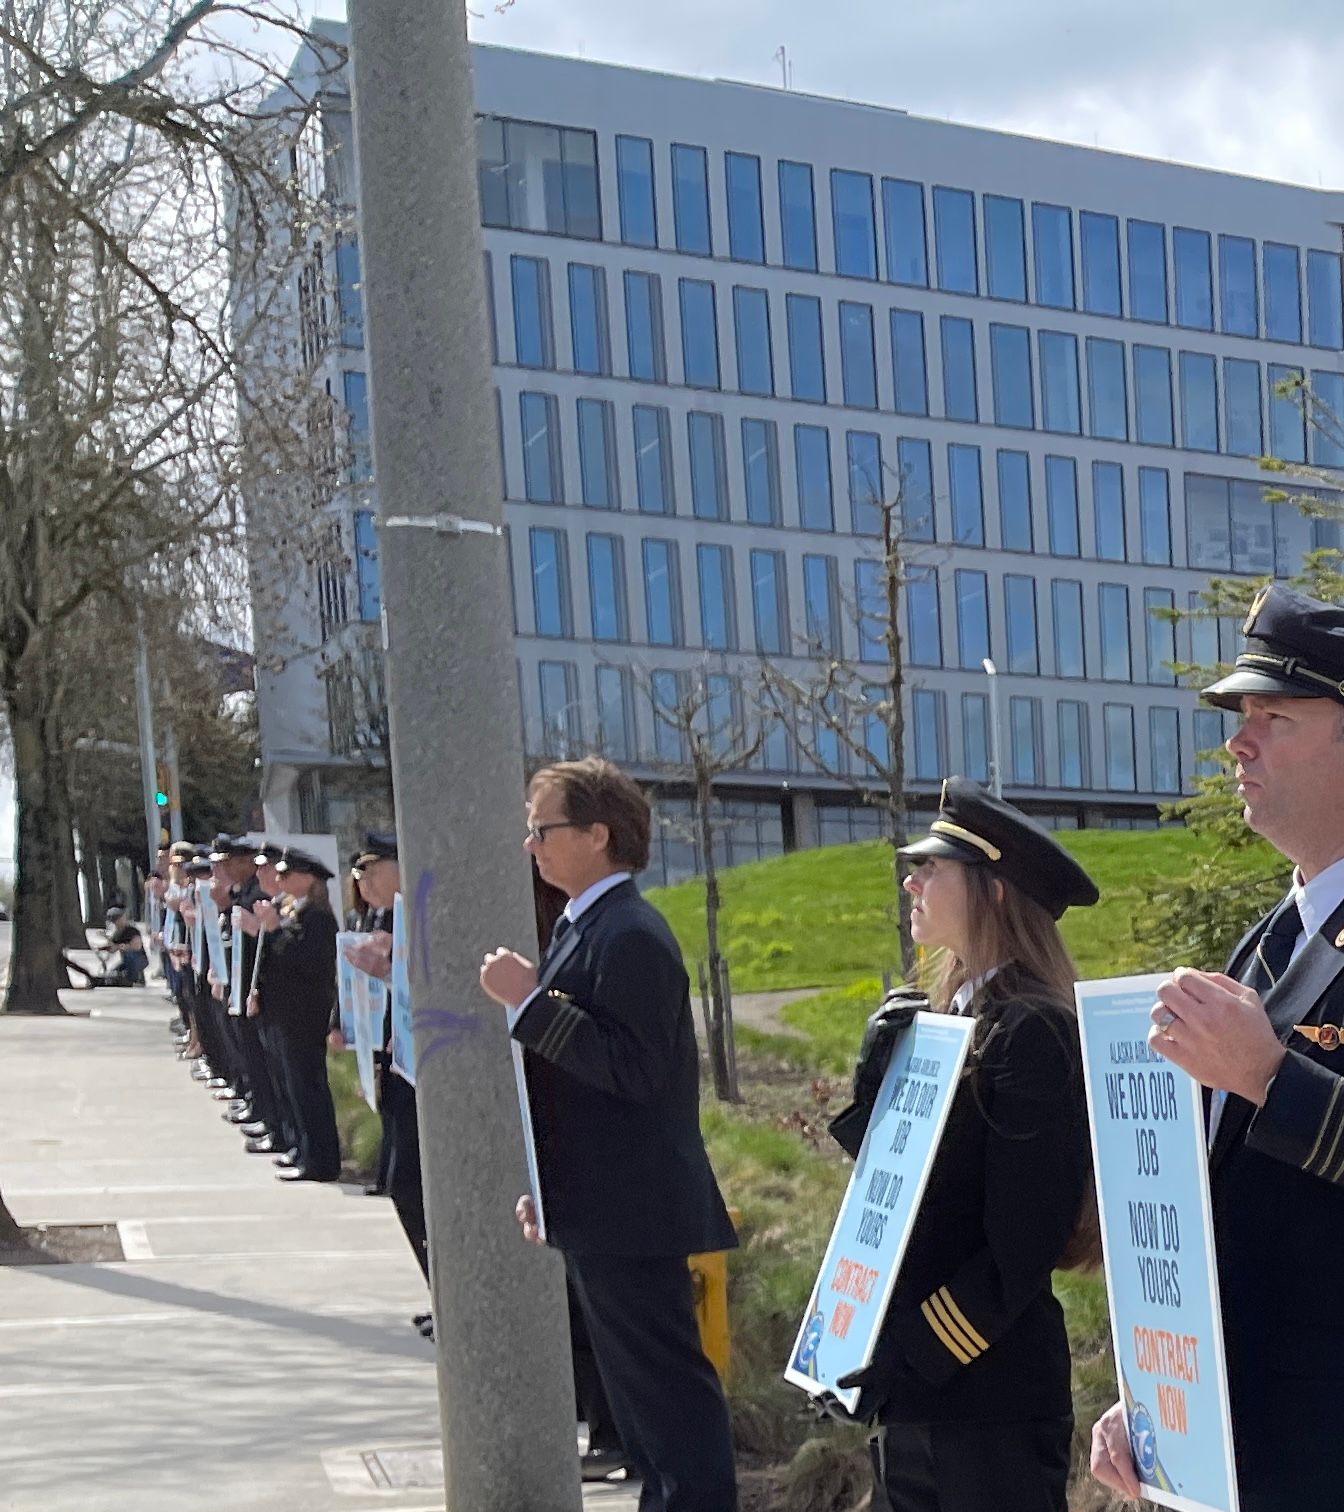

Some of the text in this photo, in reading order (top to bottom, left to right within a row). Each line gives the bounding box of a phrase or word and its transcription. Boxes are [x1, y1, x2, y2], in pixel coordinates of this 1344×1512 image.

[1105, 1071, 1178, 1120] WE DO OUR
[1136, 1128, 1159, 1176] JOB
[1128, 1200, 1180, 1253] NOW DO
[1137, 1255, 1181, 1308] YOURS
[1134, 1325, 1200, 1384] CONTRACT
[1156, 1382, 1188, 1435] NOW
